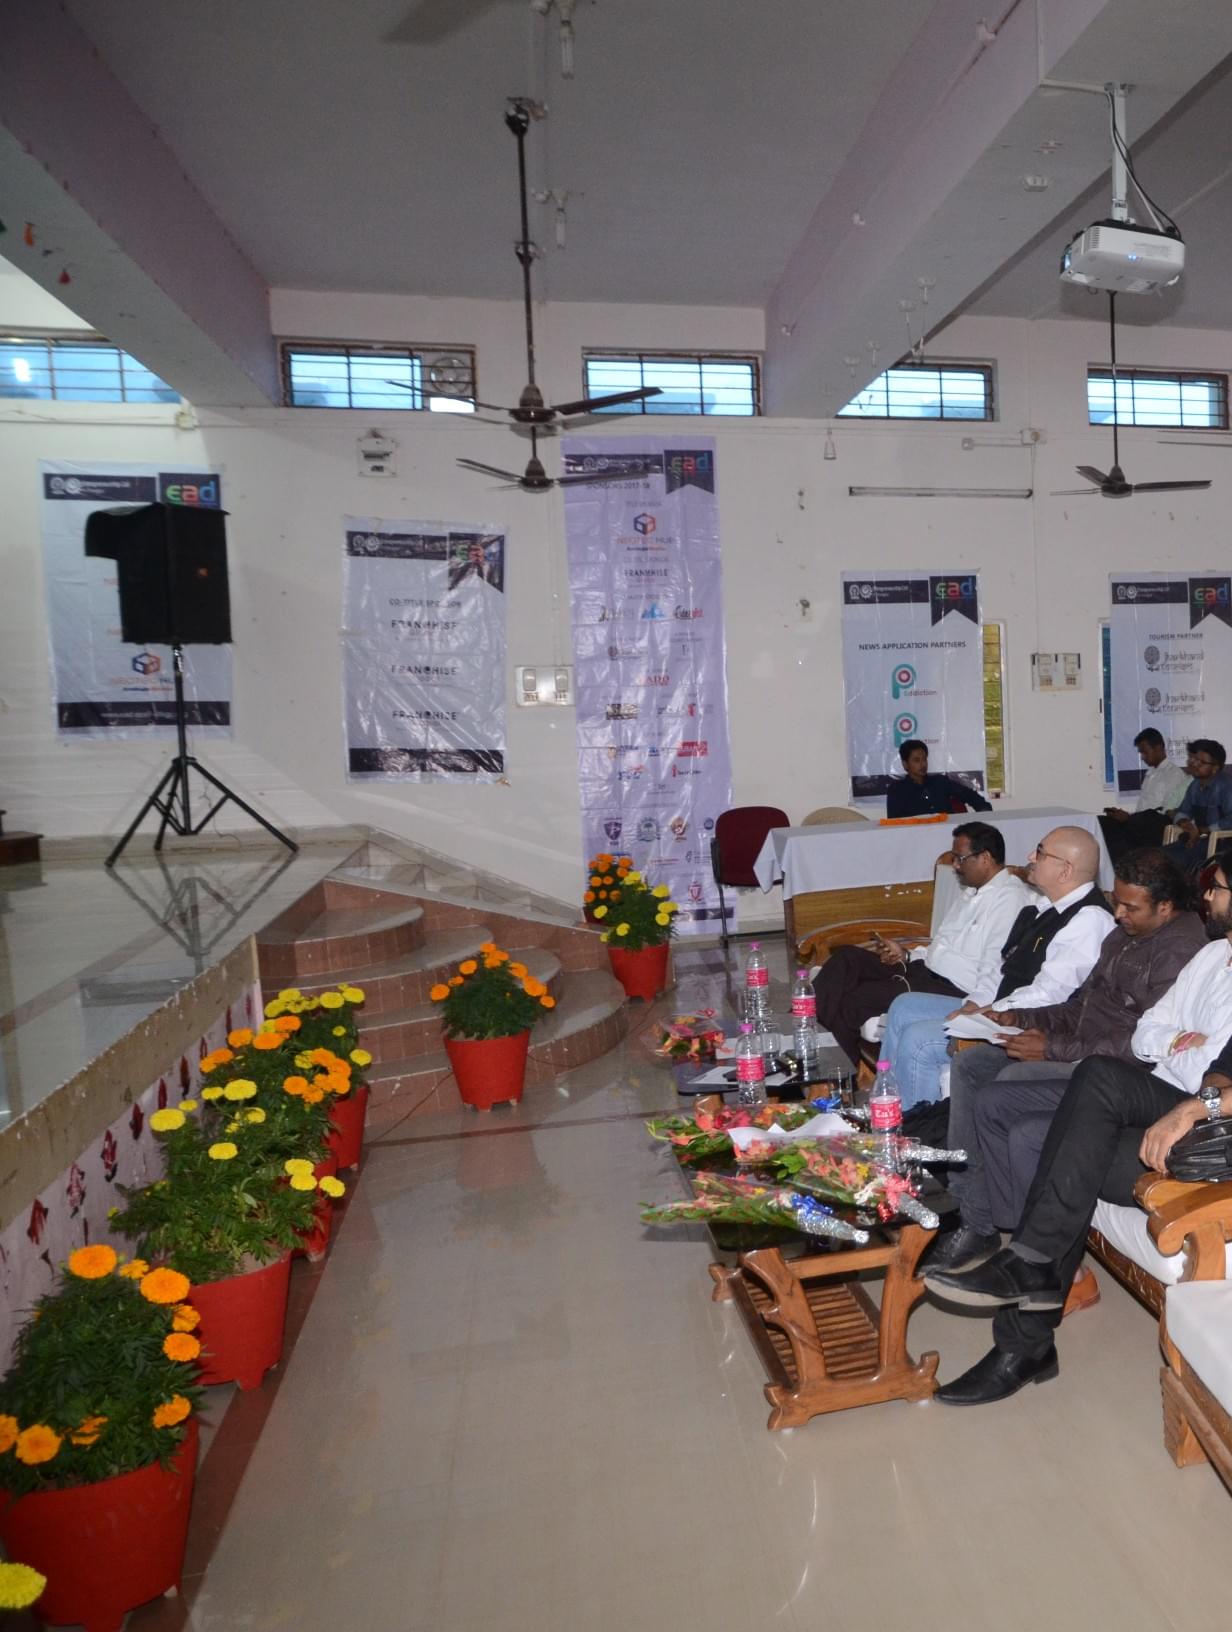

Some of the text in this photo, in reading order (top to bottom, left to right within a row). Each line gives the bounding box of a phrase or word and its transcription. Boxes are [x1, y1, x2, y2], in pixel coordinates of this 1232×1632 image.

[882, 642, 928, 650] APPLICATION
[931, 640, 966, 648] PARTNERS
[391, 665, 458, 676] FRANCHISE
